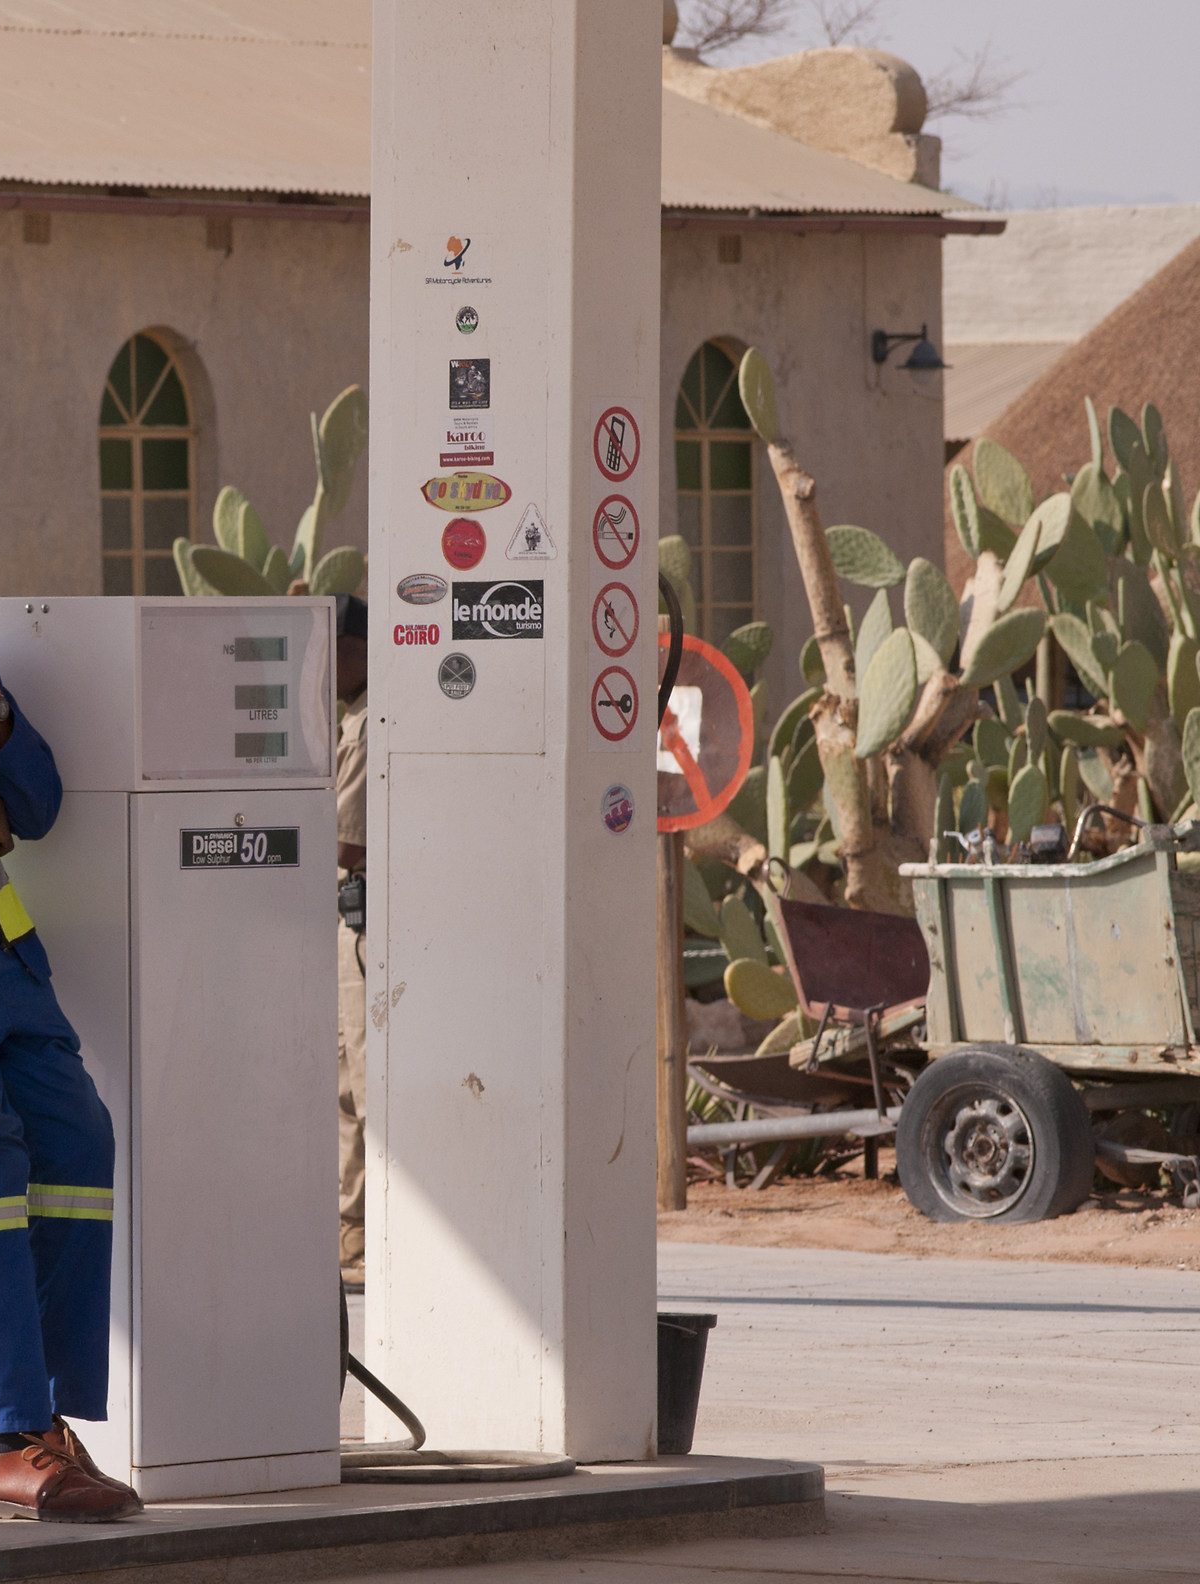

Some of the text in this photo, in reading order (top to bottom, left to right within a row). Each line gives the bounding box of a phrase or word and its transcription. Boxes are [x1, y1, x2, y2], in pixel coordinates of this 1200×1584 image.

[447, 431, 486, 442] karoo
[453, 597, 542, 622] le monde
[516, 621, 542, 630] turismo
[249, 710, 278, 721] LITRES
[192, 832, 268, 863] Diesel 50
[192, 853, 282, 866] Low Sulphur ppm
